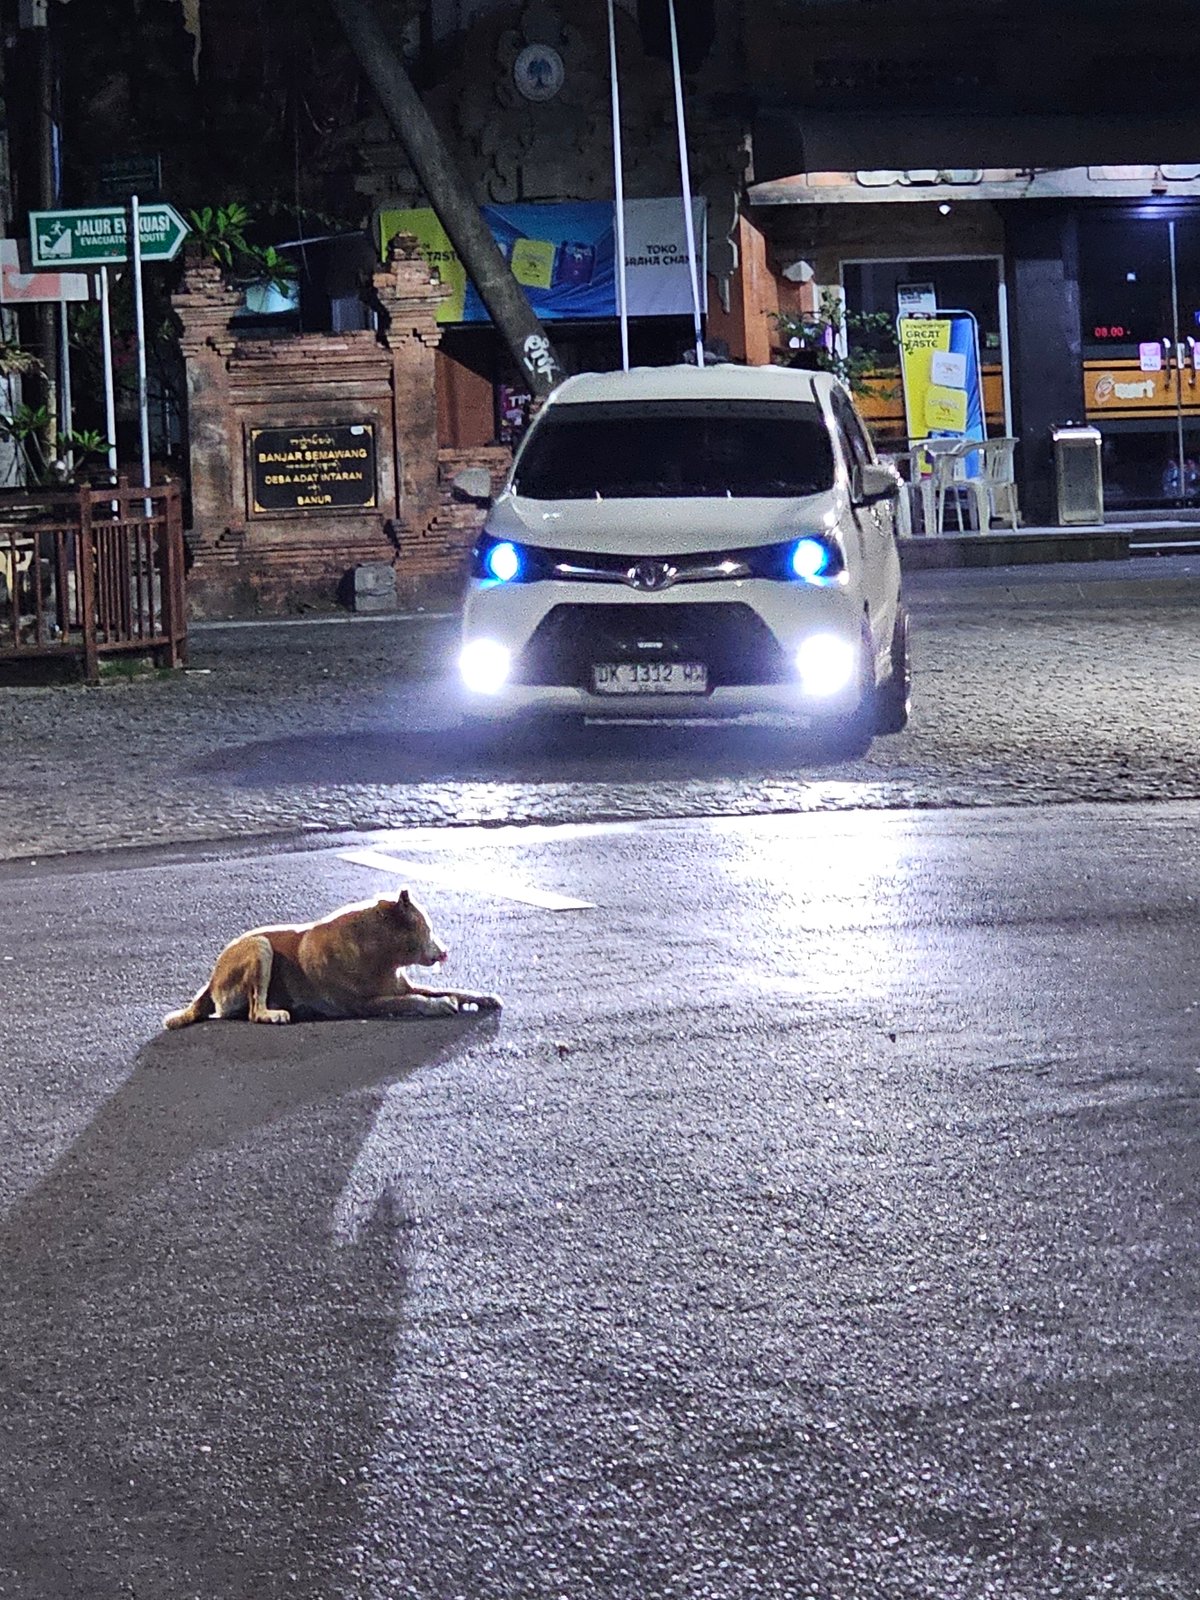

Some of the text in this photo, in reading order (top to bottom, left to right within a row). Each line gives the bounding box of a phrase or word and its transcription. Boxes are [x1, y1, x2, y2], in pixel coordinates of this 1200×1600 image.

[75, 218, 111, 236] JALUR
[646, 244, 677, 254] TOKO
[906, 330, 940, 338] GREAT
[907, 339, 938, 348] TASTE
[258, 448, 368, 463] BANJAR SEMAWANG
[293, 473, 319, 483] ADAT
[321, 471, 363, 482] INTARAN
